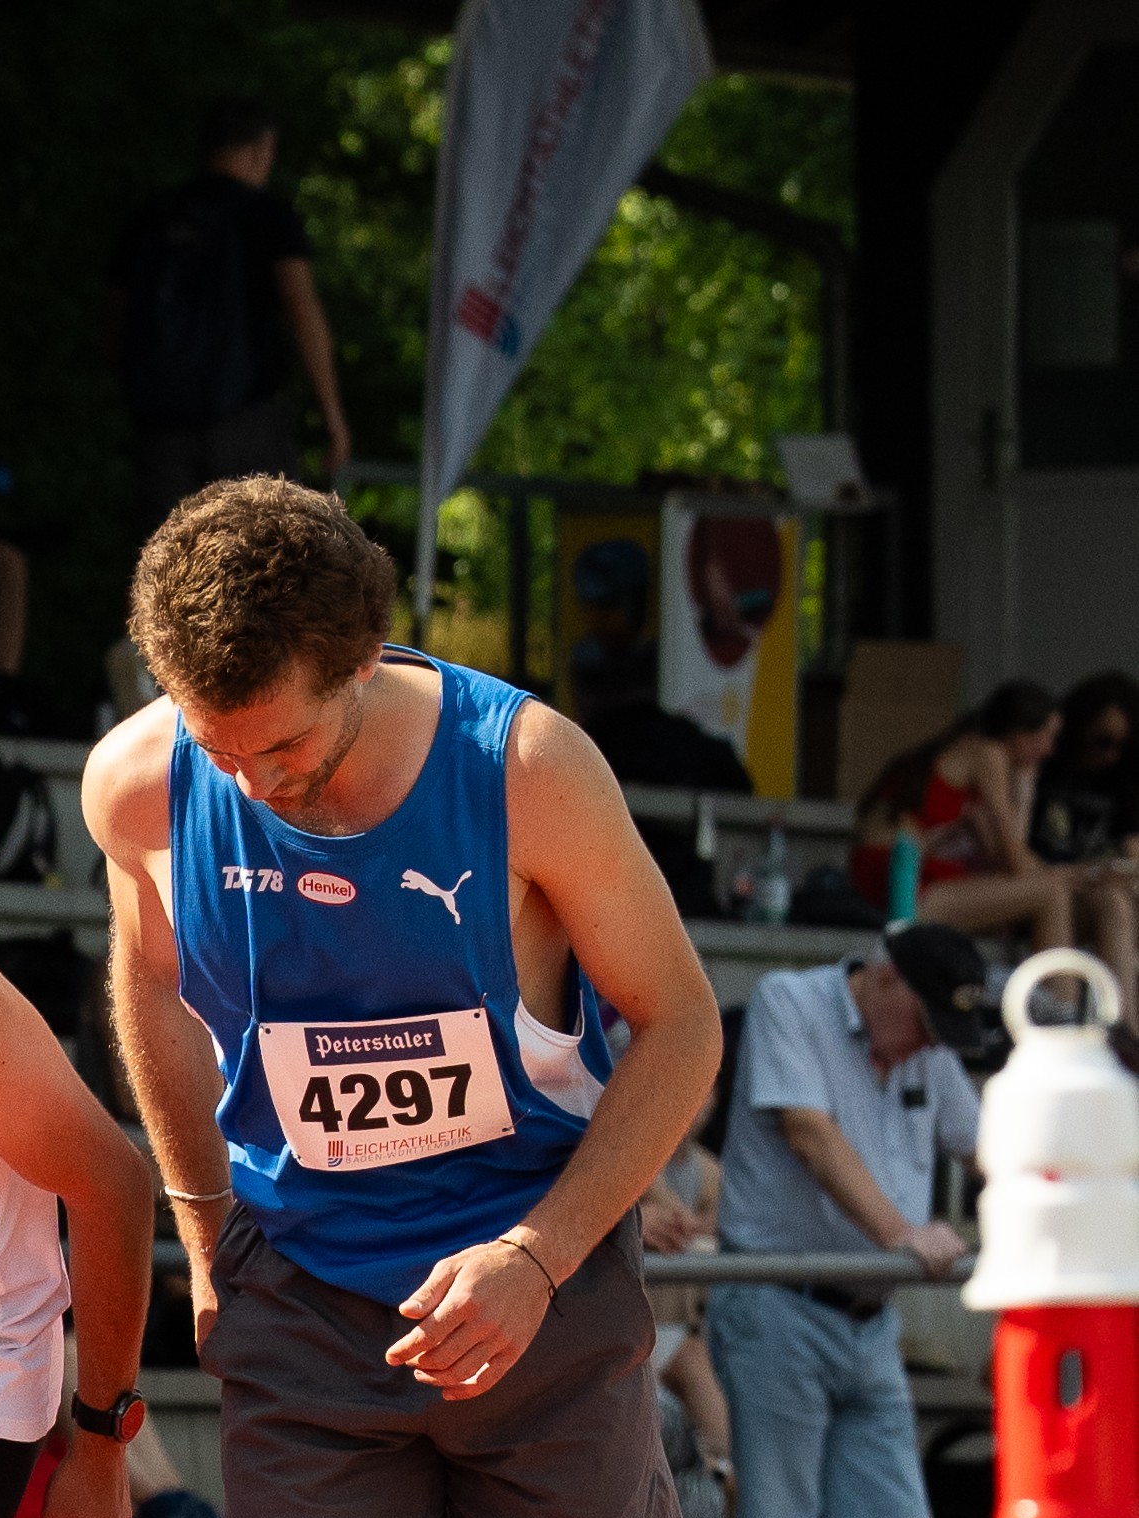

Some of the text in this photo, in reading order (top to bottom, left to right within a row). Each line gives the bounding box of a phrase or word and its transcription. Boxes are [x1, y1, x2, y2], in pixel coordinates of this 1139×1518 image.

[257, 868, 284, 893] 78
[302, 878, 352, 897] Henkel
[315, 1029, 433, 1059] Peterstaler
[298, 1063, 473, 1133] 4297
[345, 1126, 472, 1157] LEICHTATHLETIK
